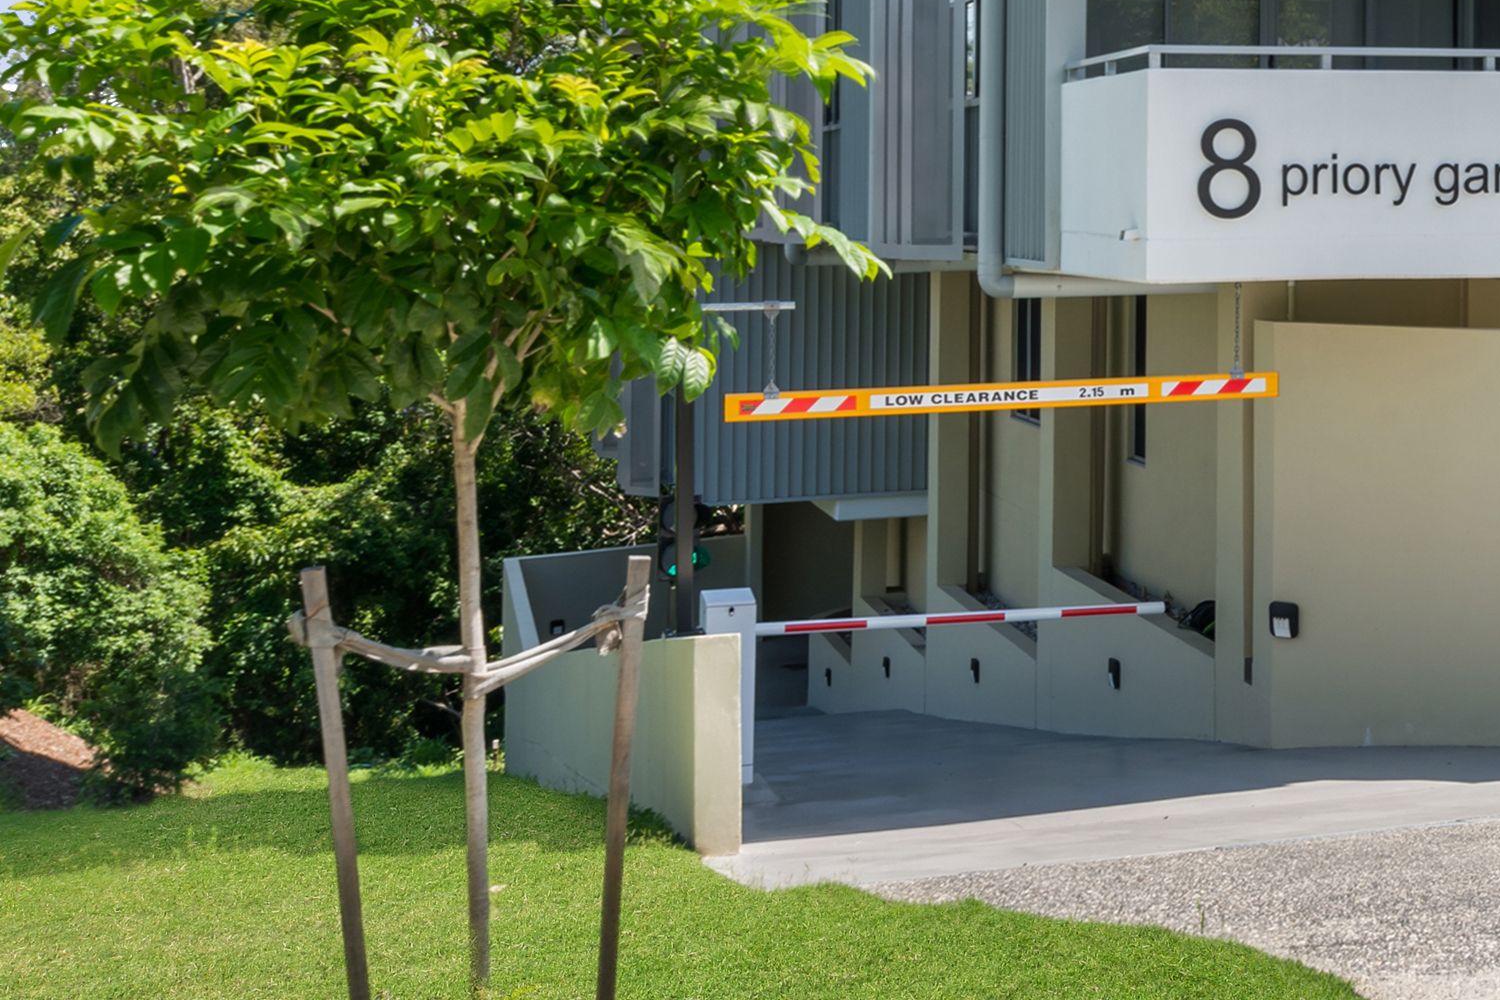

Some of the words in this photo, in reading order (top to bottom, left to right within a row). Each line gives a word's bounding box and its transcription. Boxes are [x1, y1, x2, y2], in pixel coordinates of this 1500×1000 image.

[1197, 118, 1262, 219] 8
[1281, 153, 1417, 206] priory
[885, 394, 924, 406] LOW
[931, 389, 1039, 404] CLEARANCE
[1079, 386, 1105, 398] 2.15
[1120, 387, 1135, 396] m
